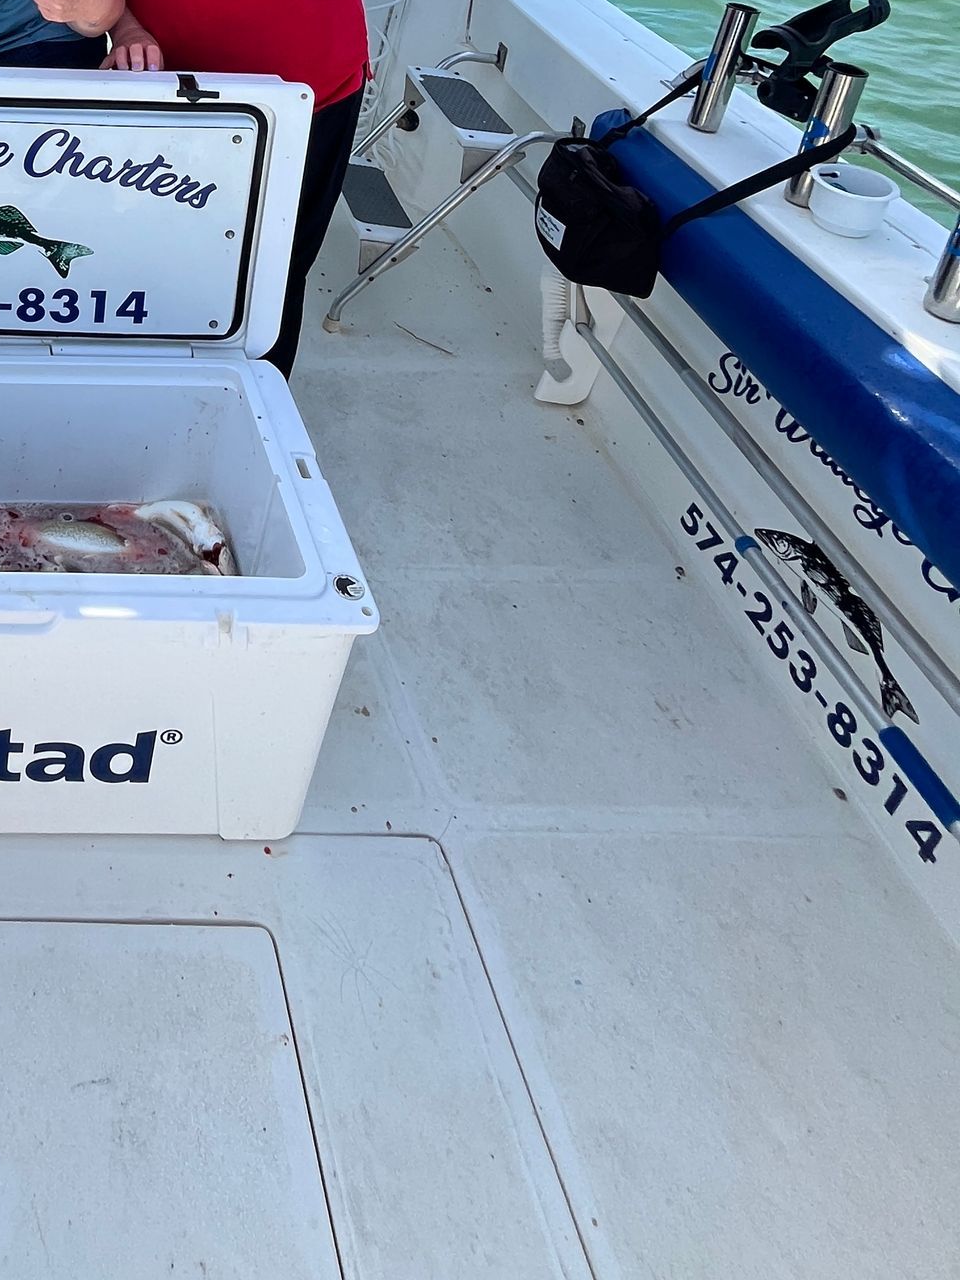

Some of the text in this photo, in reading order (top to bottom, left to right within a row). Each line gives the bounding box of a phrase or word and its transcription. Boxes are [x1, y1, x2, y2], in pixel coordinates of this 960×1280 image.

[23, 129, 218, 209] Charters
[708, 352, 762, 405] Sir
[680, 502, 943, 864] 574-253-8314
